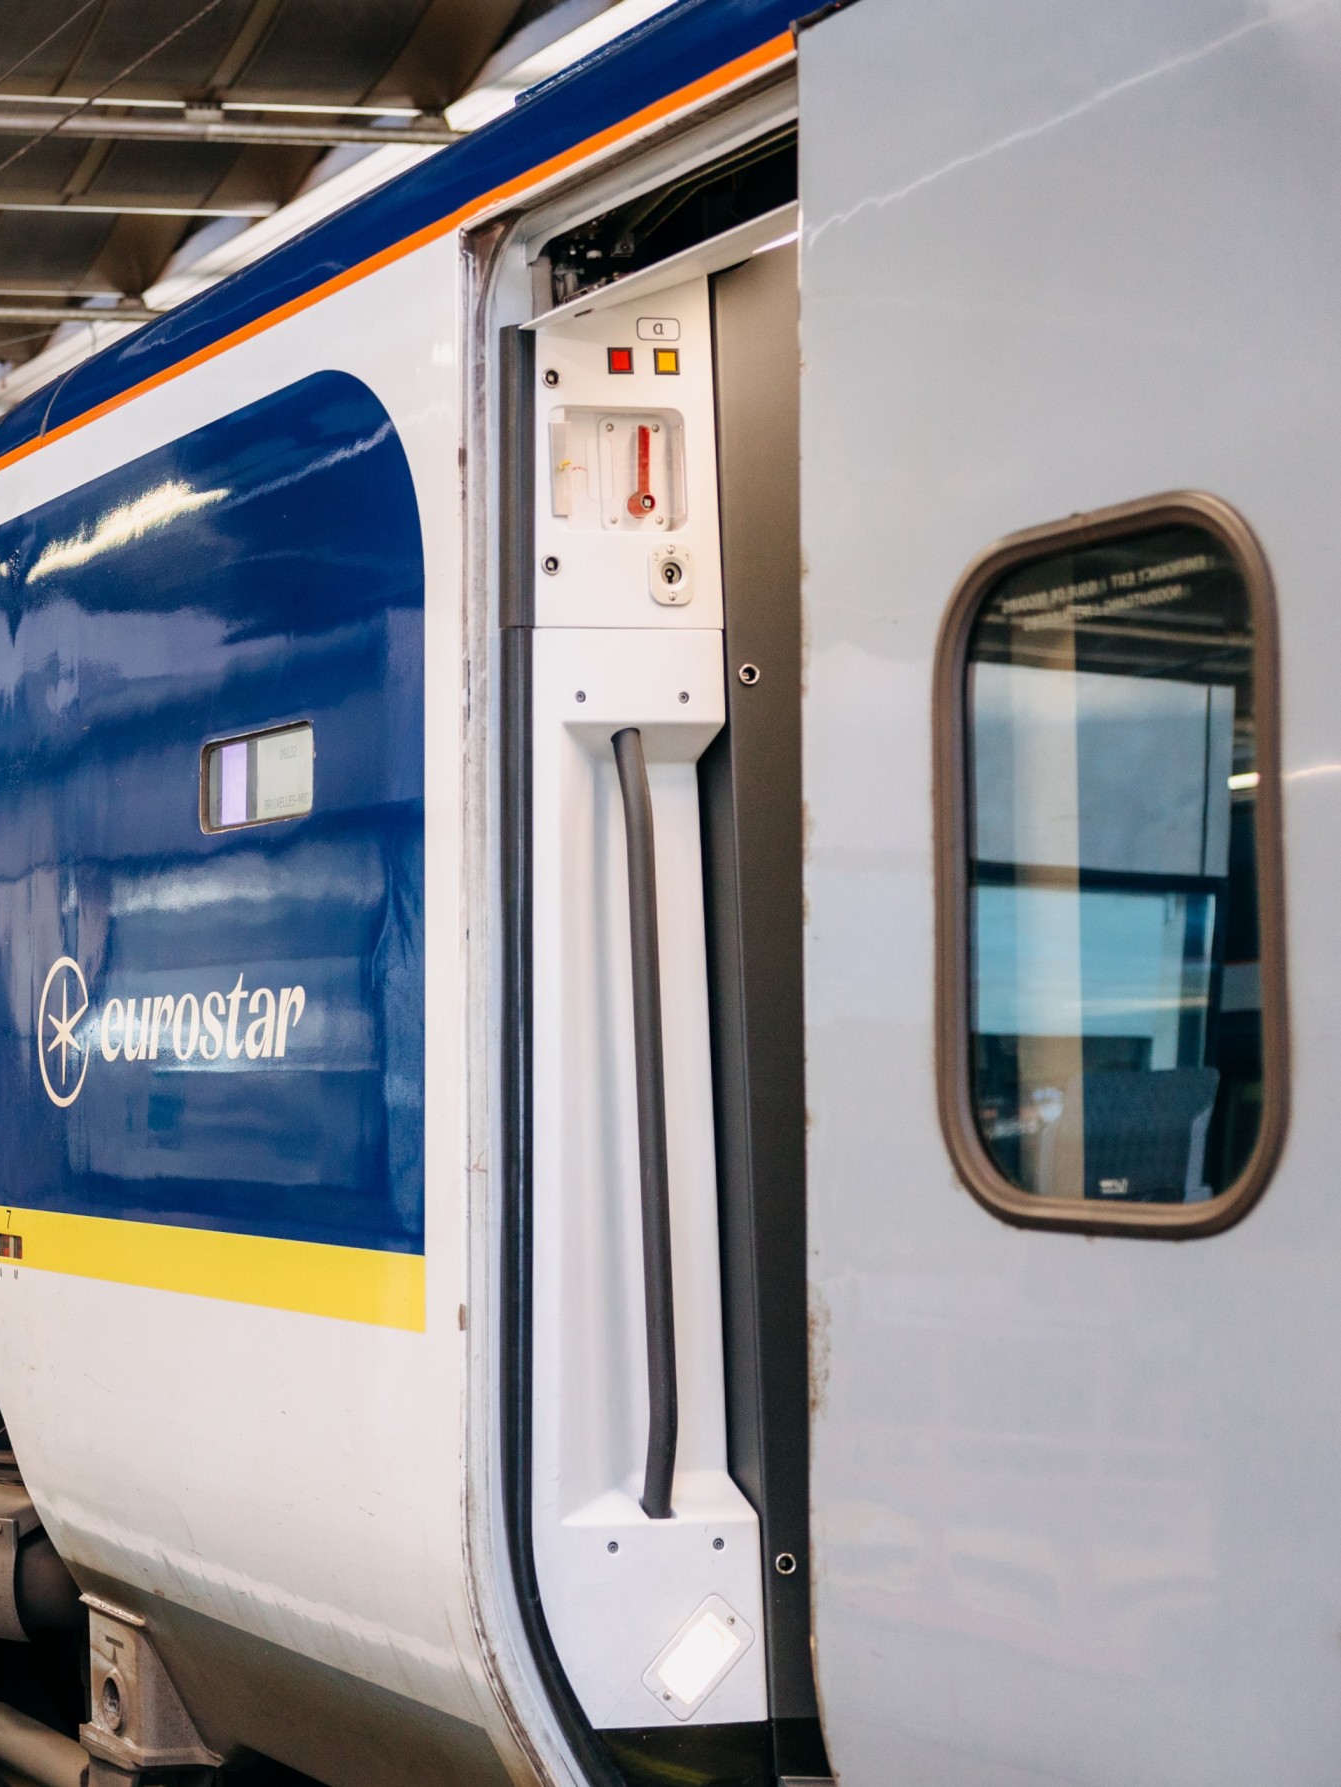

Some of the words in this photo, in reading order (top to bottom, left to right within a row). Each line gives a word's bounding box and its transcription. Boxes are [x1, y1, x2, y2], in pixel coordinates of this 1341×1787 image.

[654, 552, 659, 562] 2
[100, 972, 306, 1062] eurostar
[6, 1209, 12, 1230] 7
